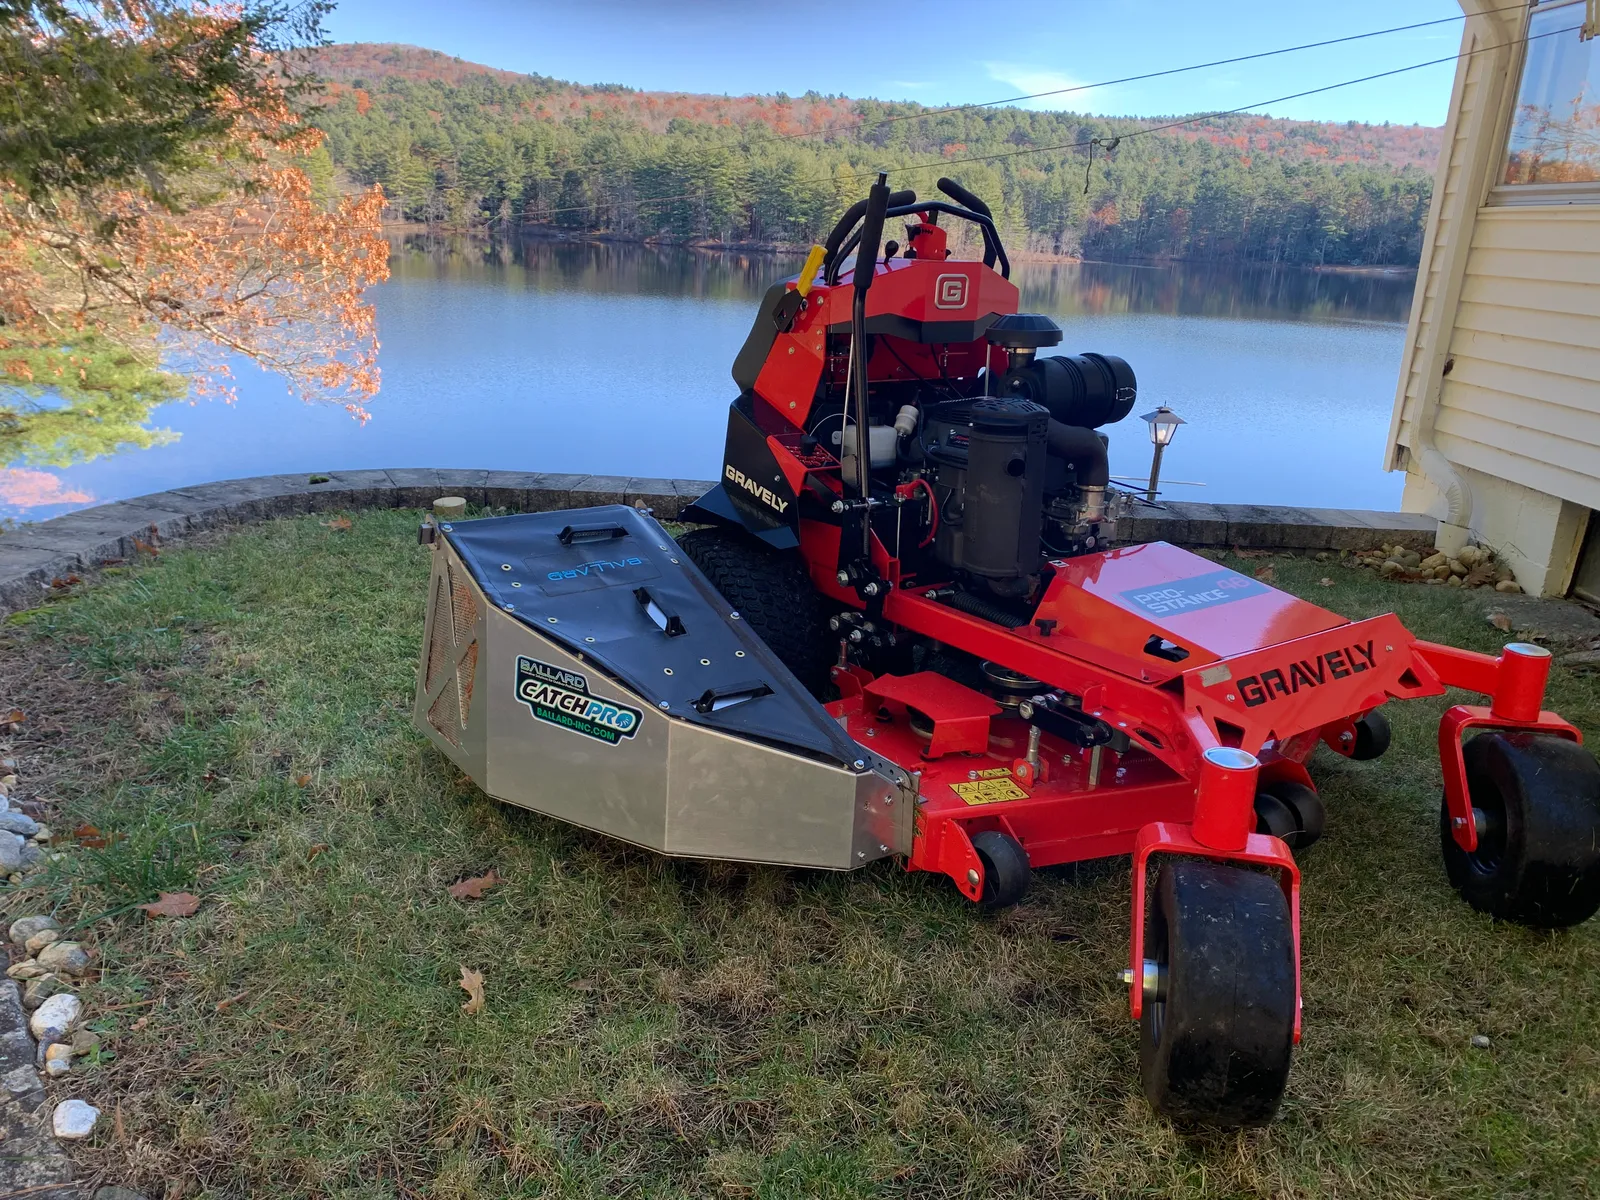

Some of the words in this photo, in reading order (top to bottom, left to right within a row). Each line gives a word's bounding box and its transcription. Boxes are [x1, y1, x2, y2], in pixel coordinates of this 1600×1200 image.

[725, 464, 789, 513] GRAVELY
[547, 557, 643, 581] BALLARD
[1133, 588, 1186, 605] PRO-
[1146, 588, 1230, 614] STANCE
[520, 658, 586, 689] BALLARD
[1236, 640, 1377, 708] GRAVELY
[536, 707, 616, 741] BALLARD-INC.COM
